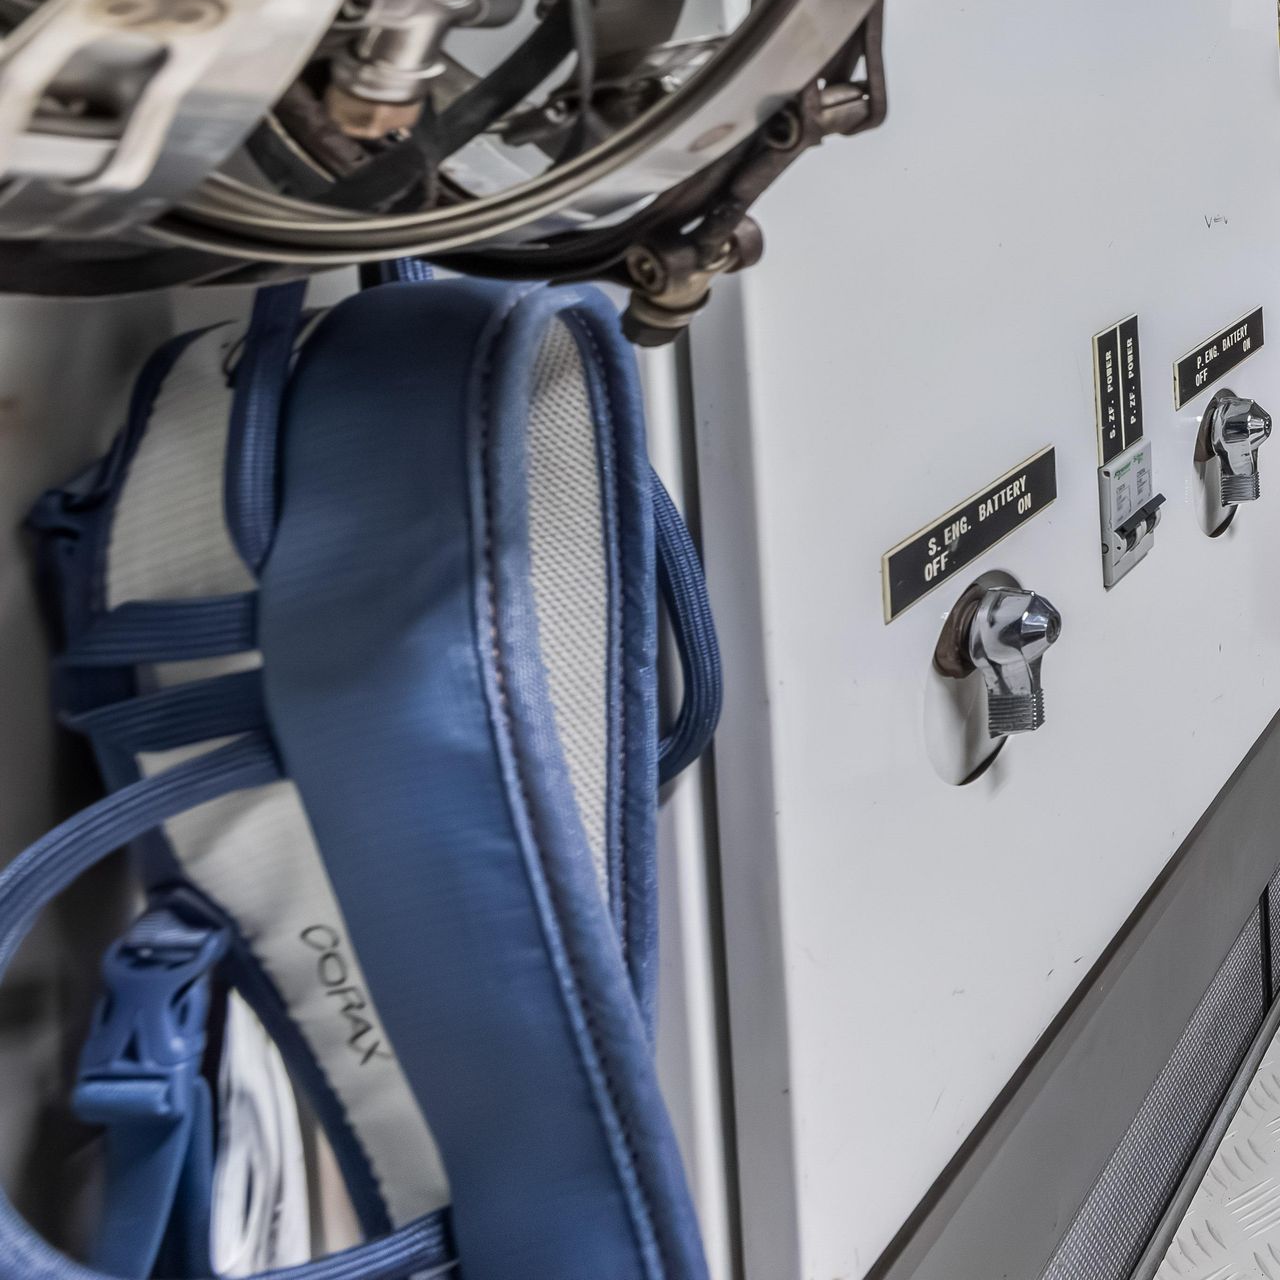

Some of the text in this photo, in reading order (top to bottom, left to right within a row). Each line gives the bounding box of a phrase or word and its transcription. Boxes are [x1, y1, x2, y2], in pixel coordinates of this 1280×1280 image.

[1126, 337, 1134, 379] POWER
[1195, 337, 1251, 387] OFF ON
[1222, 323, 1248, 352] BATTERY
[1105, 350, 1114, 393] POWER
[924, 492, 1032, 582] OFF ON
[927, 475, 1027, 556] S. ENG. BATTERY
[301, 924, 393, 1066] CORAX
